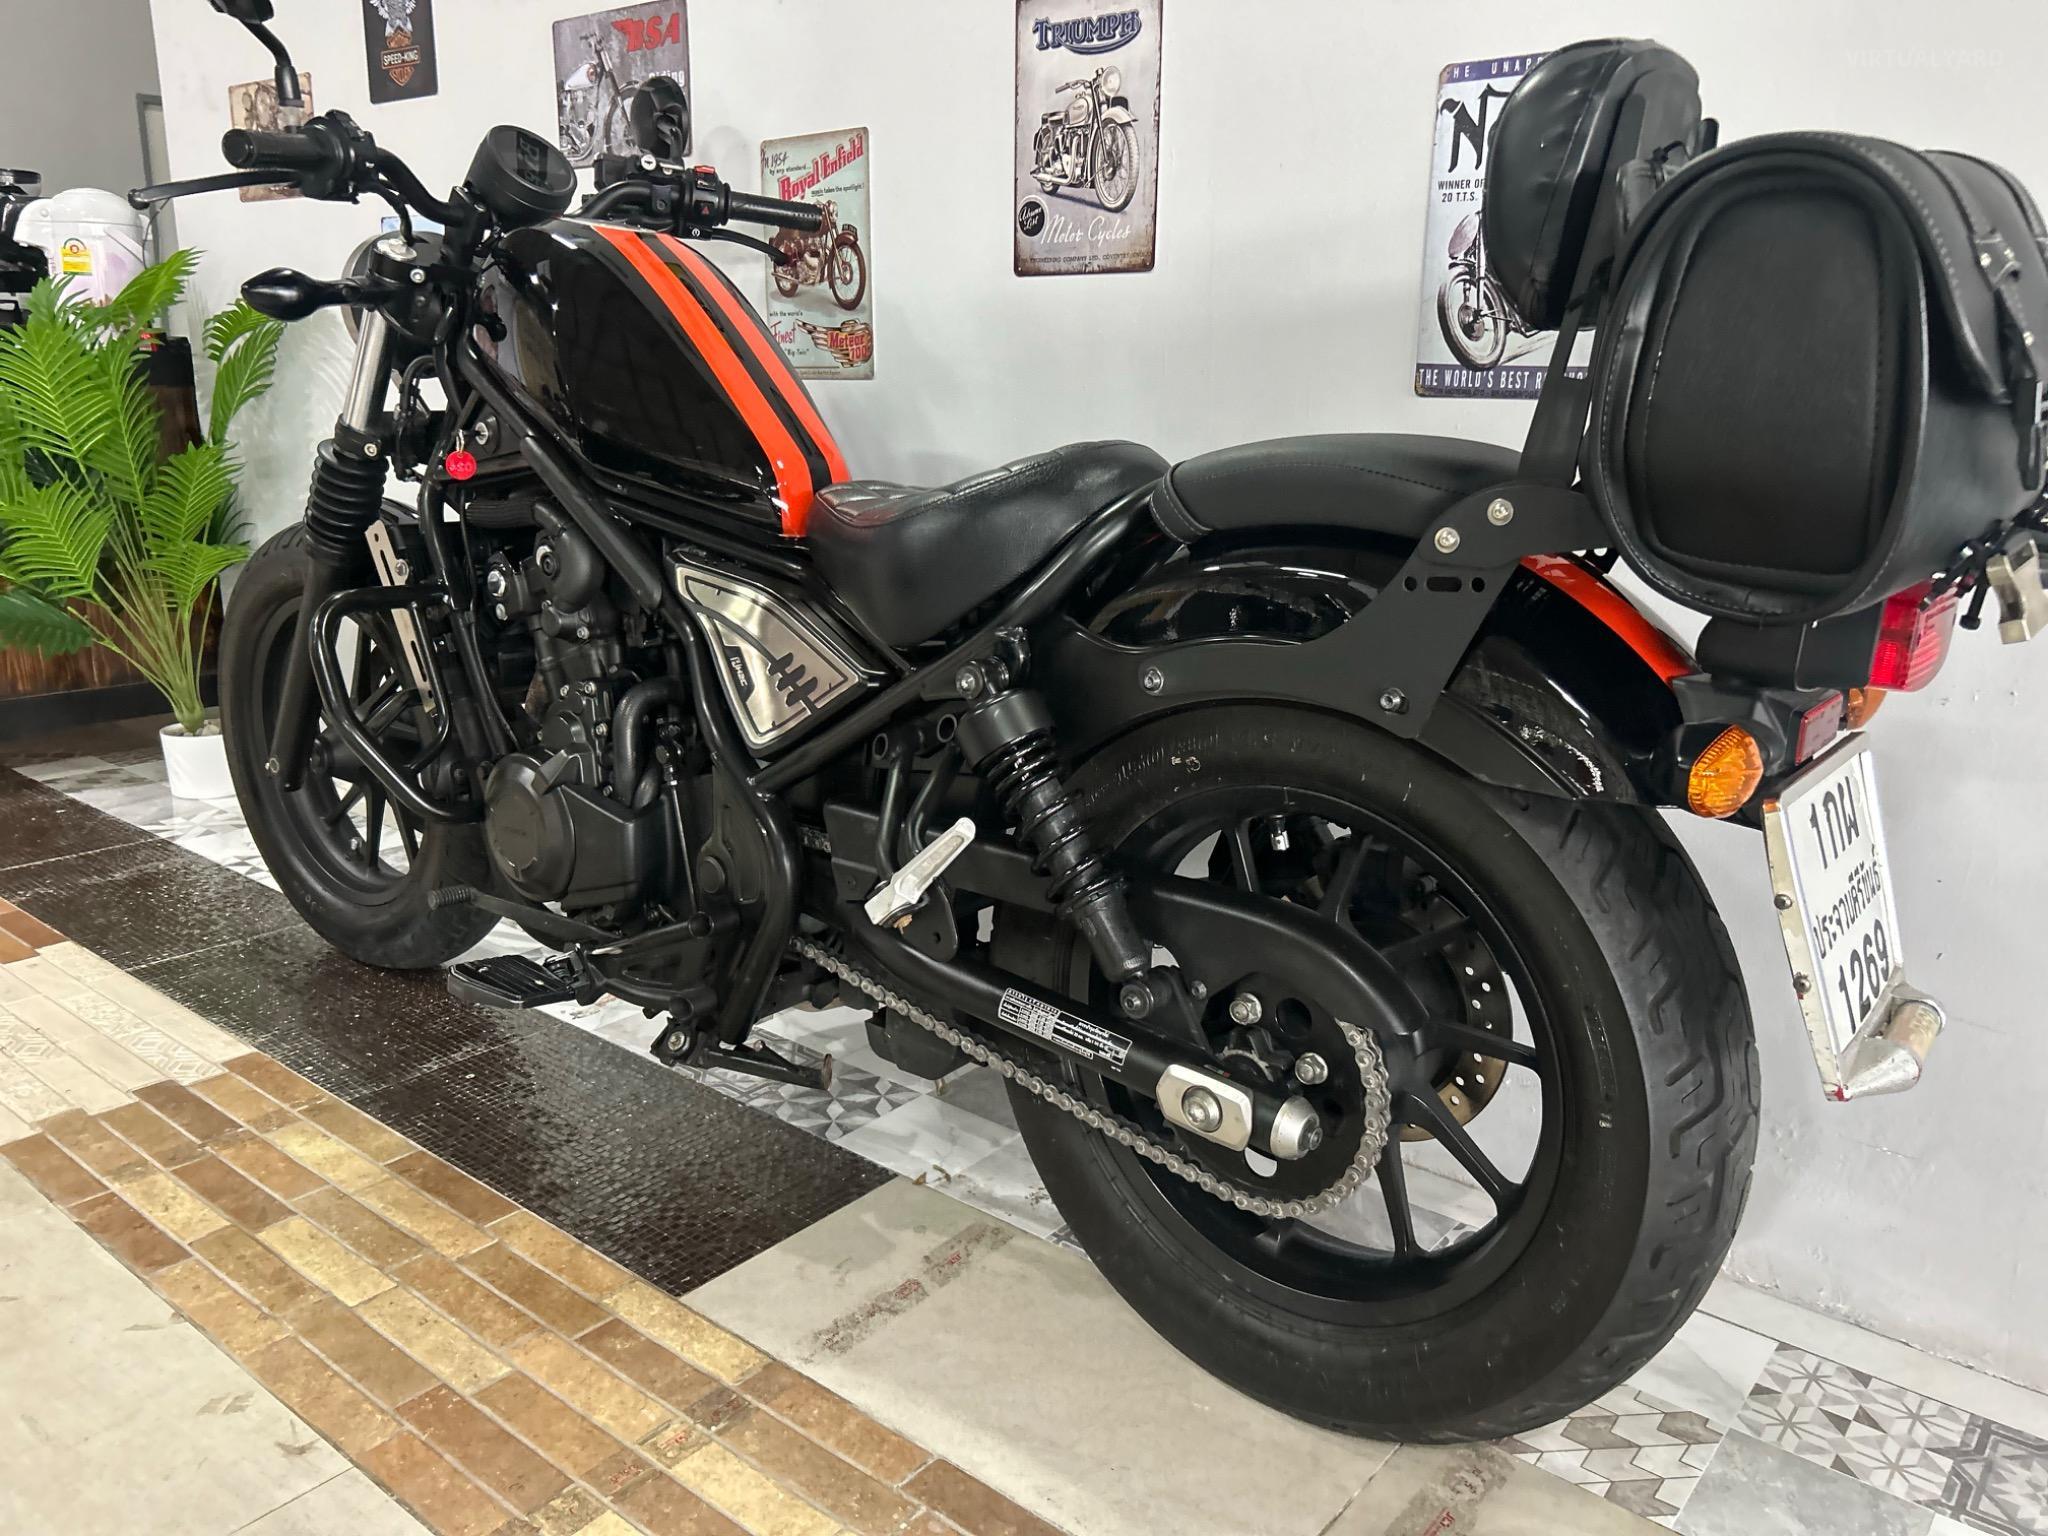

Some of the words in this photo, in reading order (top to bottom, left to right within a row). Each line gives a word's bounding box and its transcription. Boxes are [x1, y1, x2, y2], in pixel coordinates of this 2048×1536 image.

[612, 12, 680, 53] BSA
[1032, 9, 1142, 53] TRIUMPH
[777, 158, 821, 201] Royal
[819, 132, 864, 180] Enfield
[1438, 179, 1471, 190] WINNER
[1441, 192, 1453, 202] 20
[1040, 214, 1084, 244] Motor
[1088, 215, 1132, 247] Cycles
[827, 330, 866, 350] Meteor
[1419, 368, 1439, 386] THE
[1444, 369, 1494, 389] WORLD'S
[1500, 371, 1530, 389] BEST
[1839, 919, 1890, 1035] 1269
